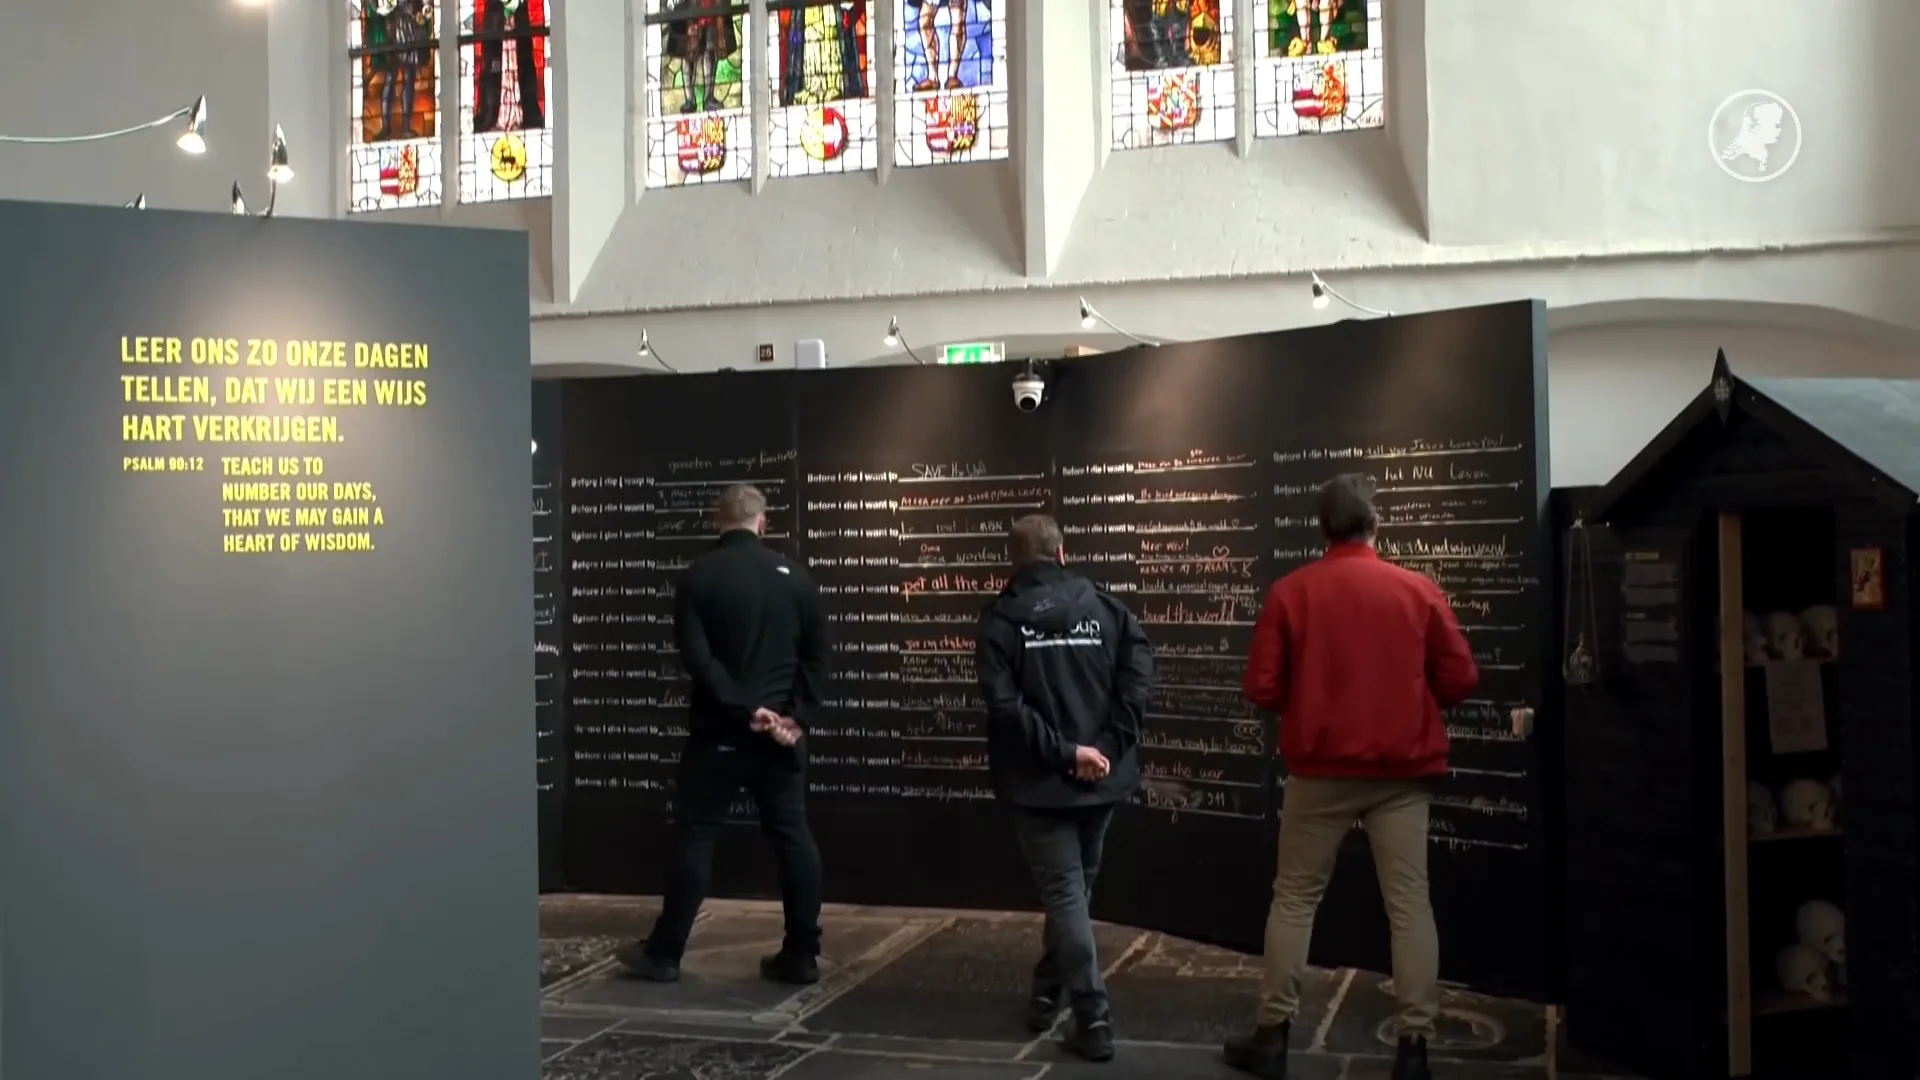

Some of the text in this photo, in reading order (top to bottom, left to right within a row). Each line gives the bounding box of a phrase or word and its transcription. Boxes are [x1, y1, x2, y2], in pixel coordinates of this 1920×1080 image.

[121, 336, 428, 369] LEER ONS ZO ONZE DAGEN
[121, 375, 426, 407] TELLEN, DAT WIJ EEN WIJS
[122, 414, 344, 443] HART VERKRIJGEN.
[123, 456, 204, 472] PSALM 90:12
[221, 456, 323, 475] TEACH US TO
[222, 482, 377, 503] NUMBER OUR DAYS,
[223, 507, 384, 527] THAT WE MAY GAIN A
[223, 532, 375, 552] HEART OF WISDOM.
[931, 573, 949, 590] all
[955, 573, 979, 592] the
